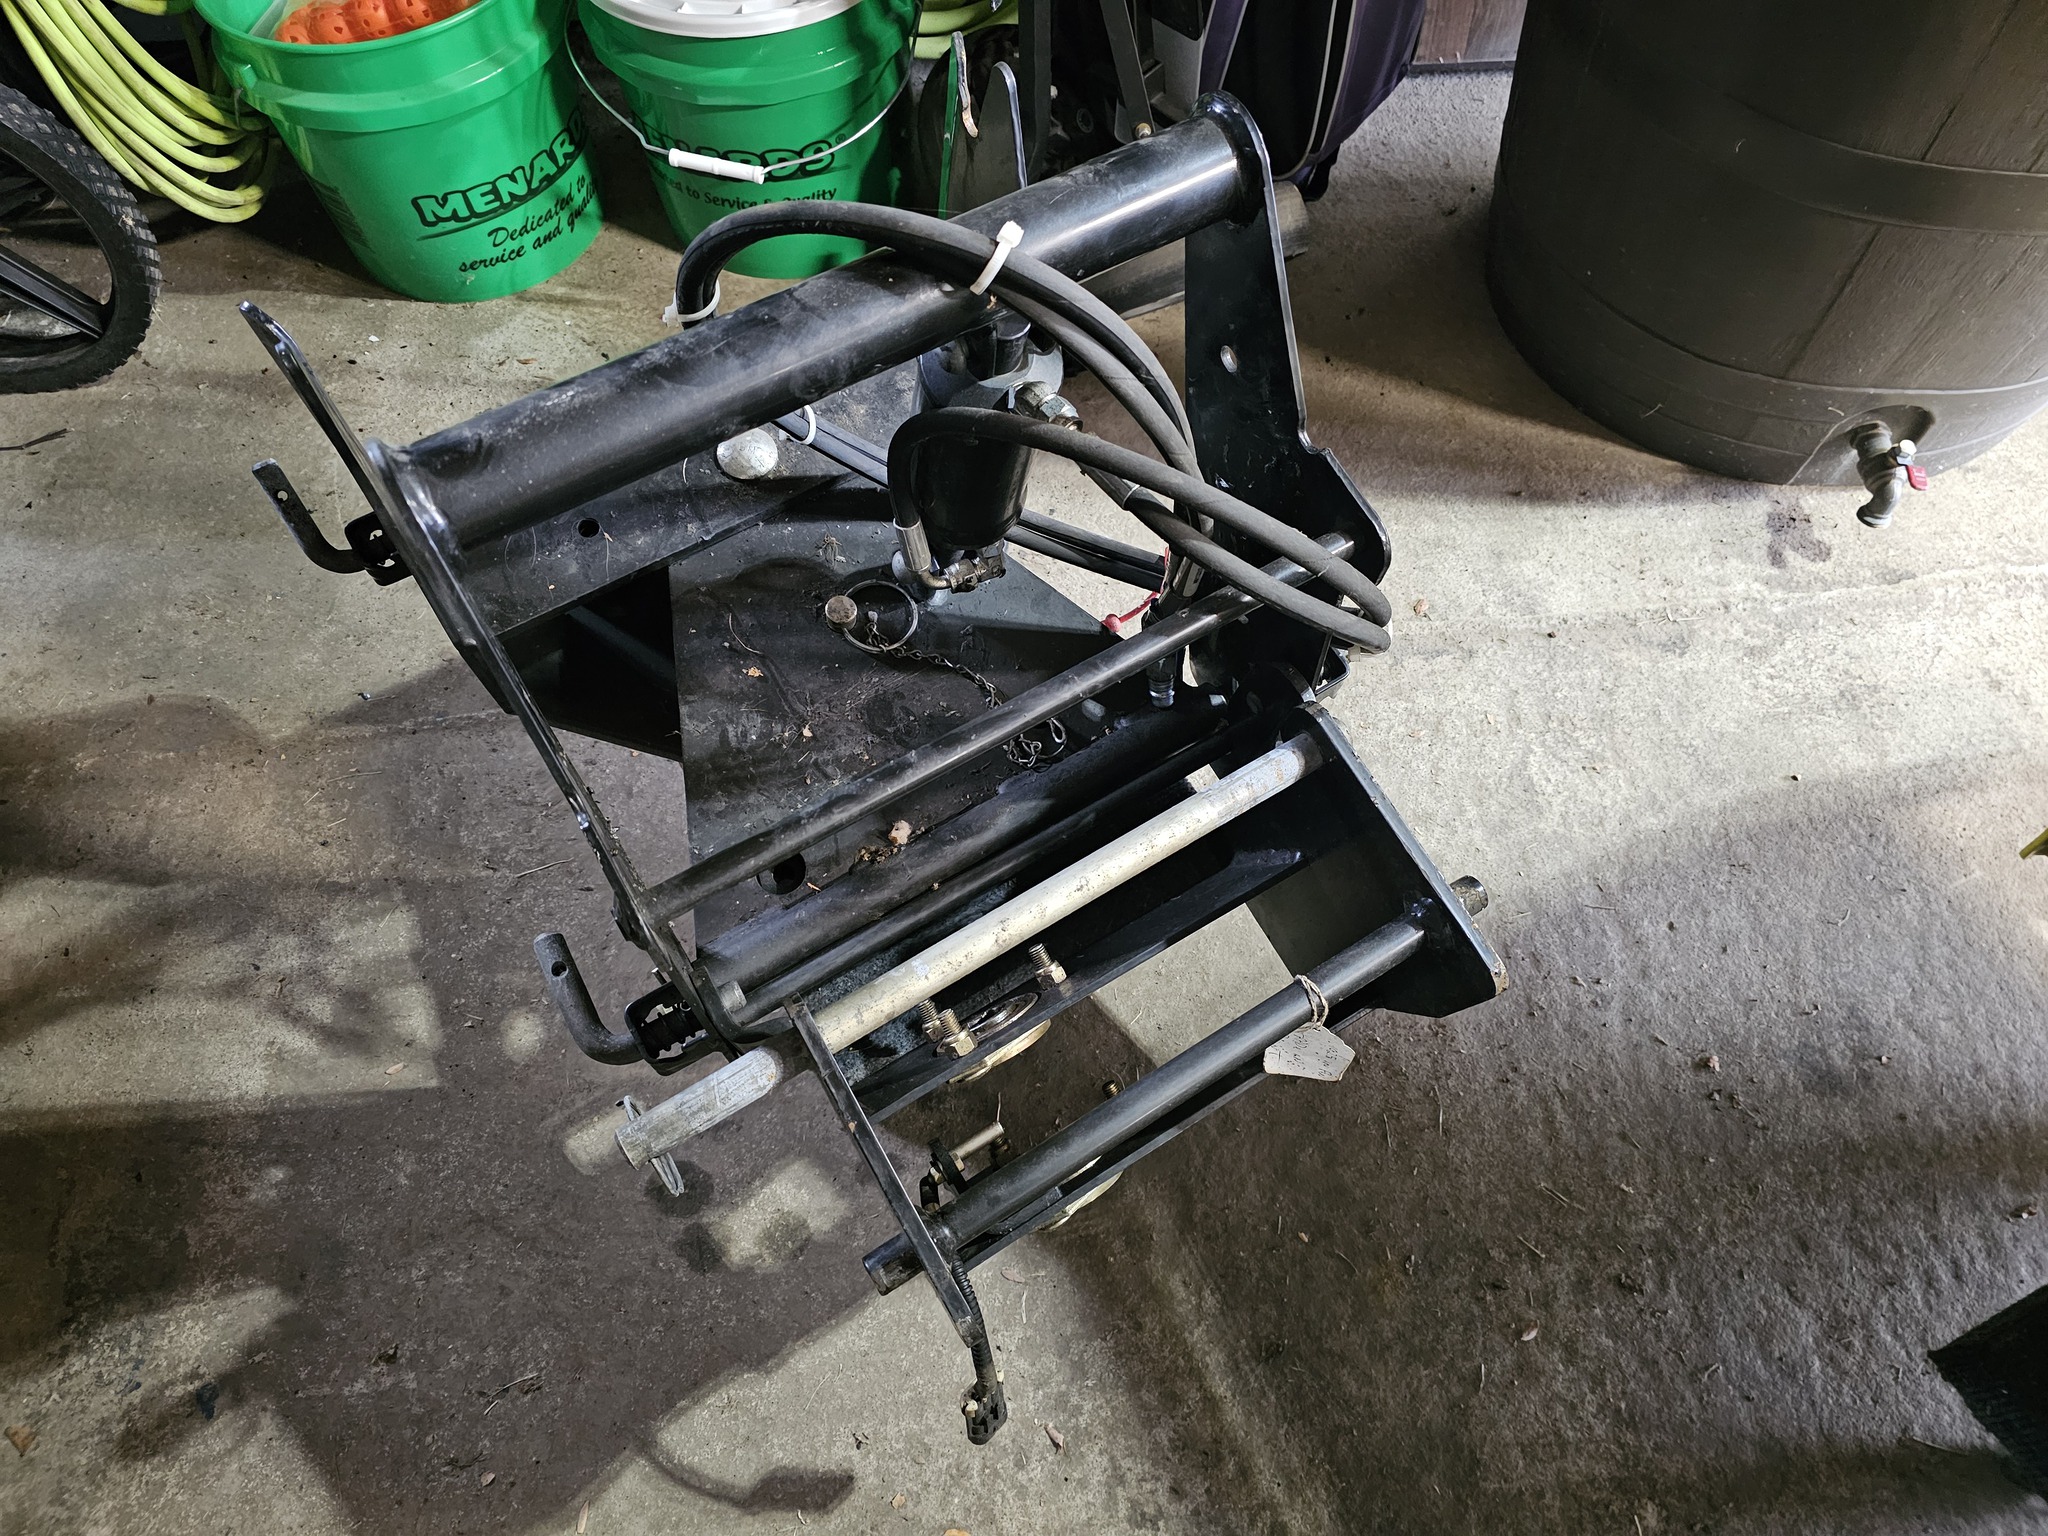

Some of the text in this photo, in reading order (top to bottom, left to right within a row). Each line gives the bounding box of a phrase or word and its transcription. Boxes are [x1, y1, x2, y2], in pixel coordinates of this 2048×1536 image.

[487, 173, 586, 247] Dedicated to
[685, 184, 700, 200] to
[704, 192, 757, 210] Service
[458, 243, 527, 273] service
[532, 216, 564, 250] and
